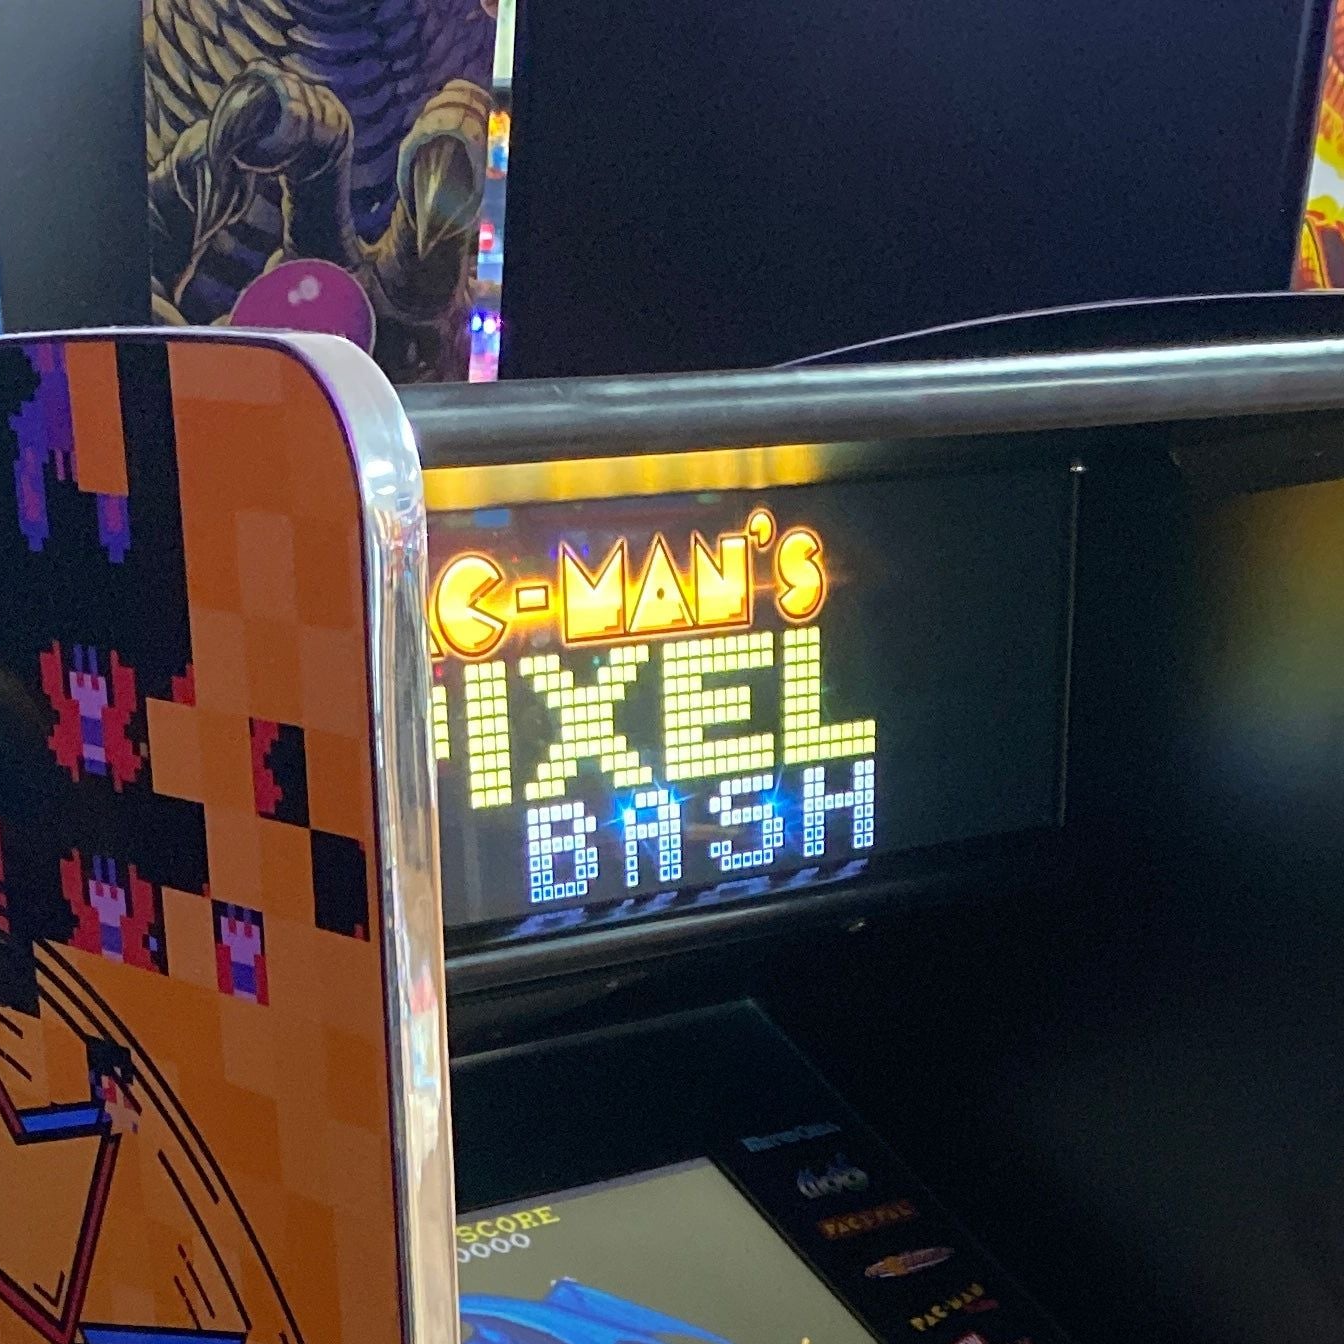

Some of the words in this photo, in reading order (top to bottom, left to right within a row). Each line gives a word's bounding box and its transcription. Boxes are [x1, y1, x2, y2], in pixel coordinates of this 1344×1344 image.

[431, 508, 825, 659] C-MAN'S
[527, 759, 875, 903] BASH
[455, 1206, 561, 1243] SCORE
